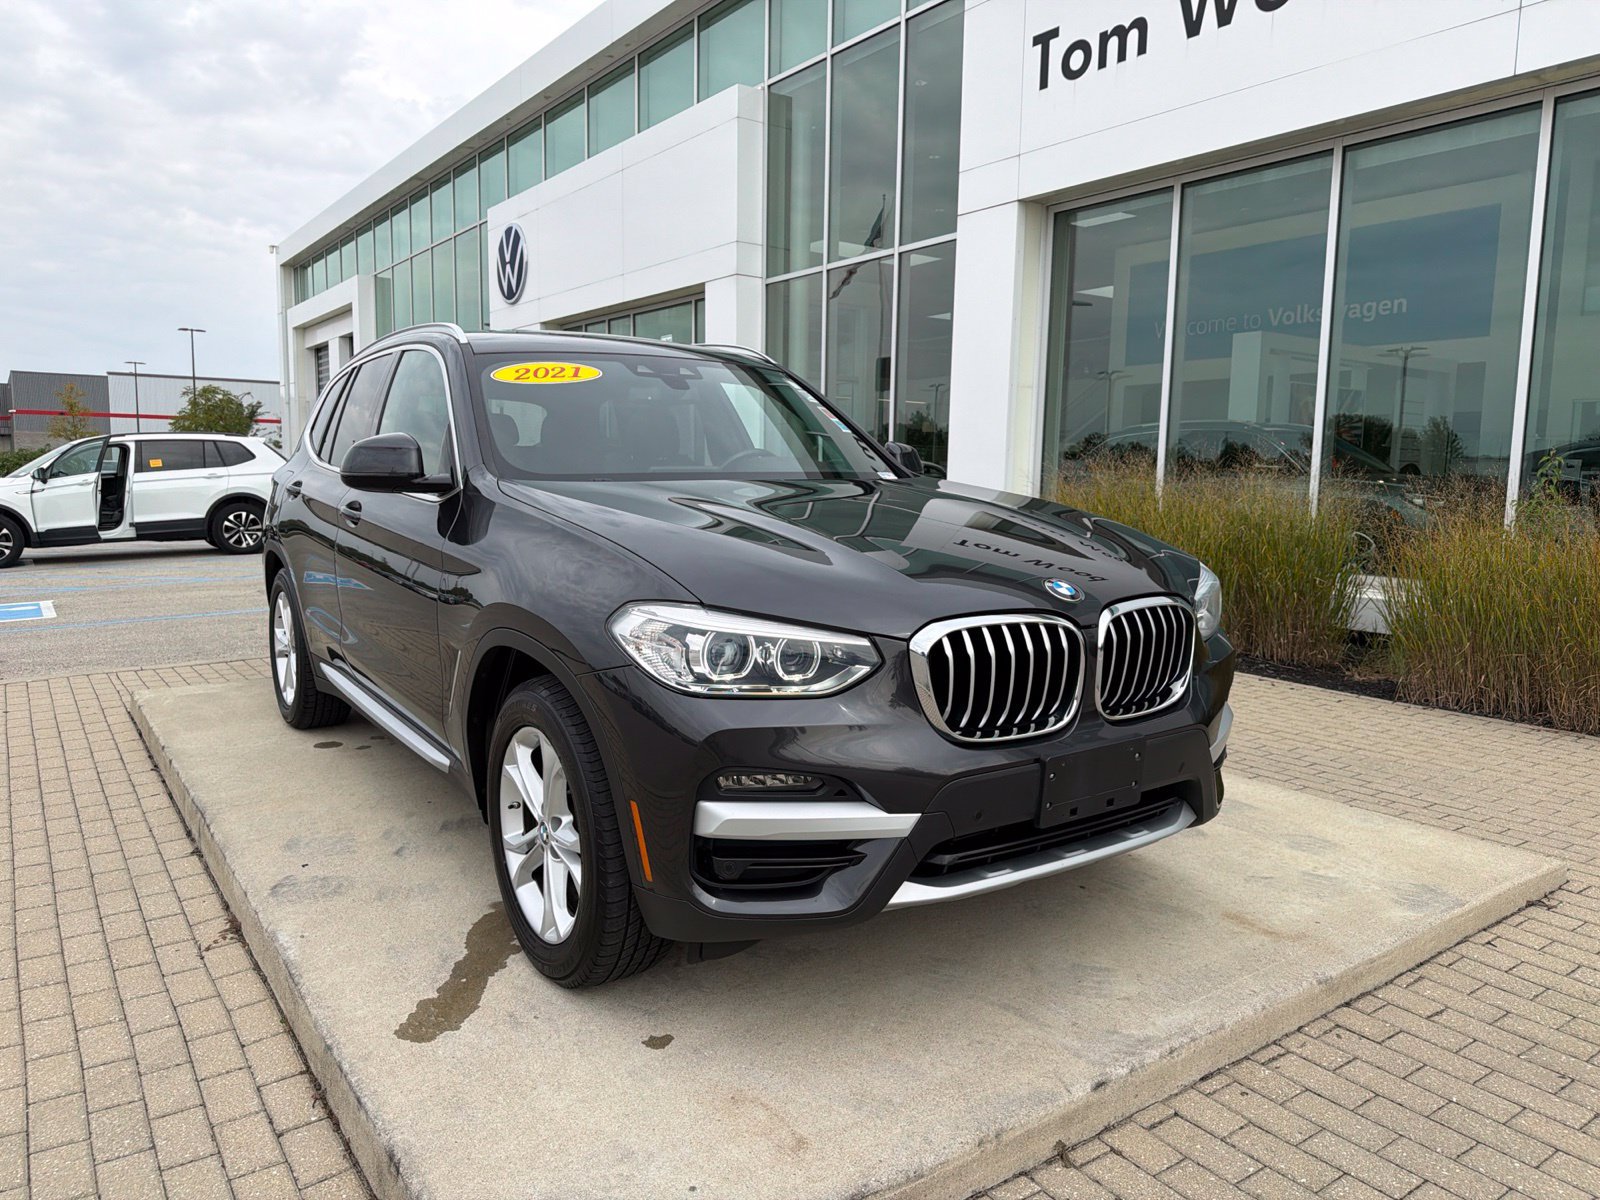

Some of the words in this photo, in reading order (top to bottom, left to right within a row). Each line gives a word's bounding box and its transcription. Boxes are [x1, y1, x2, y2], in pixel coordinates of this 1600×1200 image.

[1032, 16, 1148, 91] Tom
[1243, 313, 1261, 330] to
[1267, 297, 1408, 327] Volksagen
[513, 366, 582, 381] 2021
